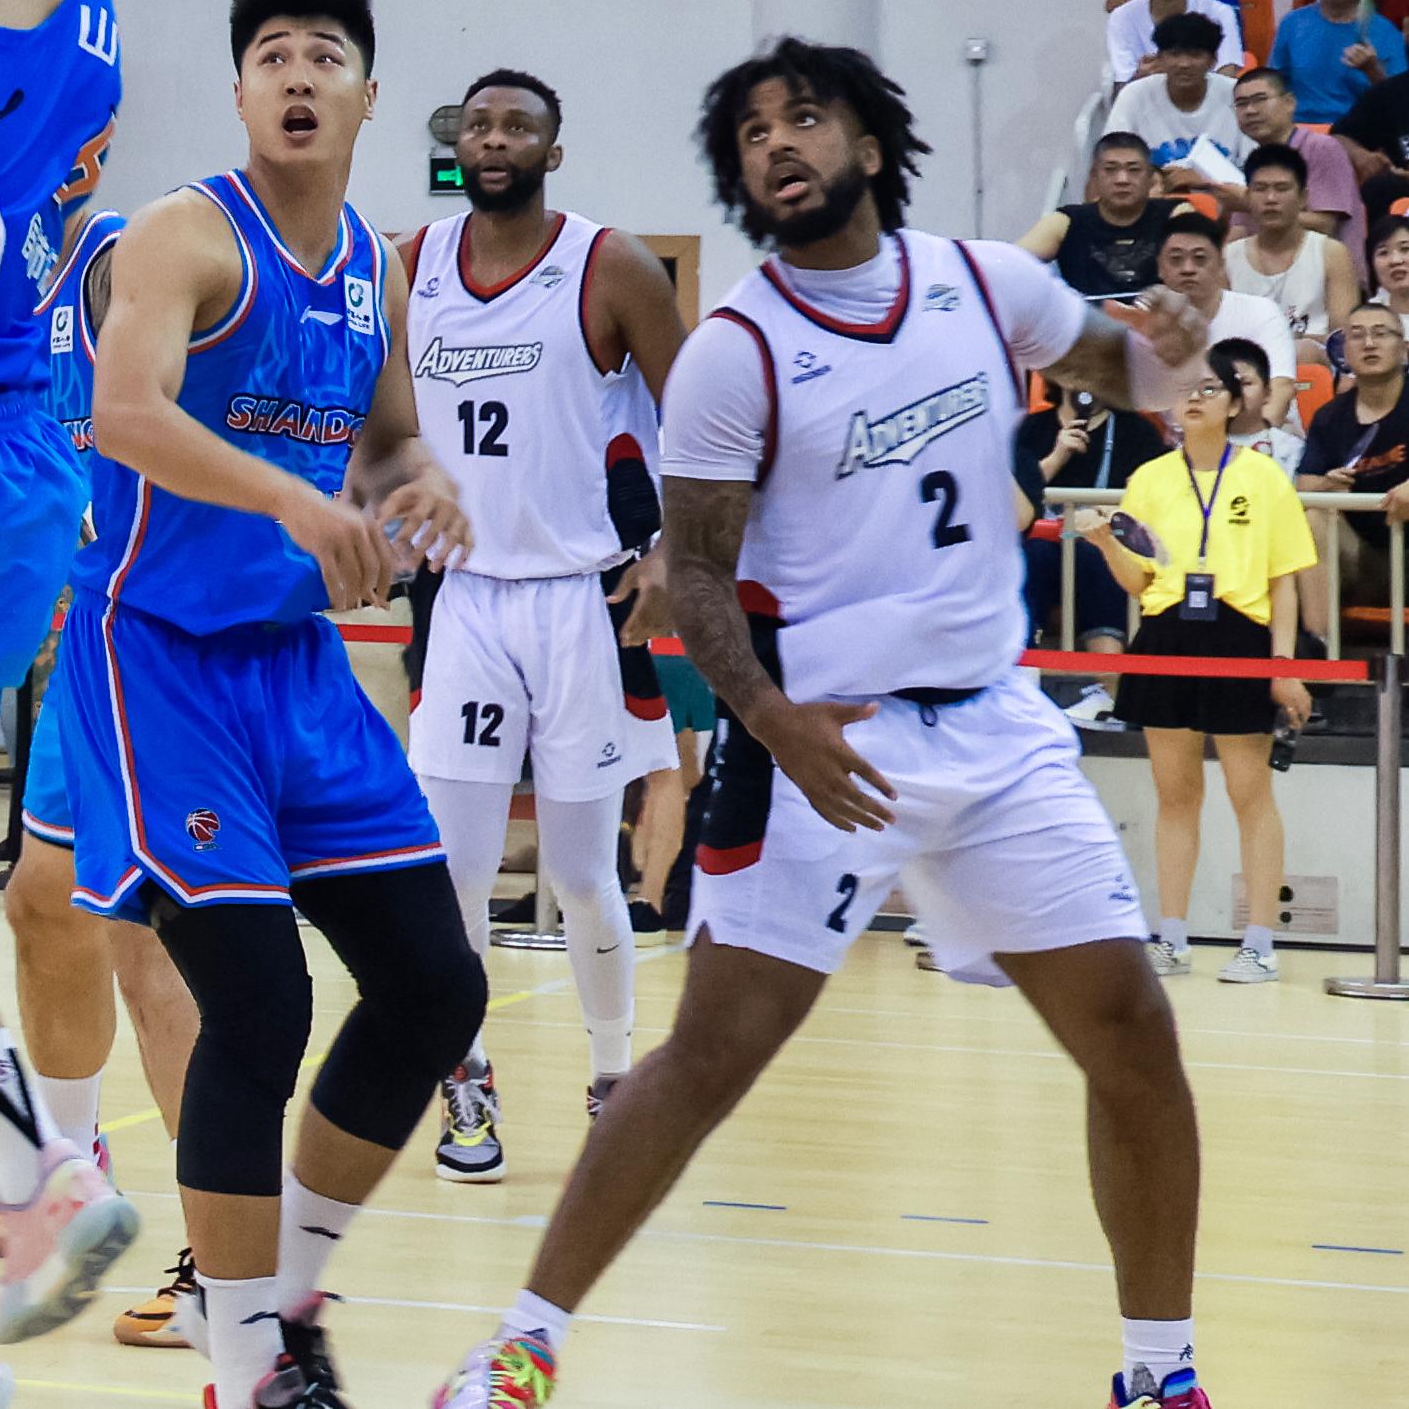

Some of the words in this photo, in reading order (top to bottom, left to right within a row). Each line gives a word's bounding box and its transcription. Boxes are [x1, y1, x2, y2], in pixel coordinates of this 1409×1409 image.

[457, 399, 509, 457] 12
[920, 469, 974, 550] 2
[460, 701, 505, 747] 12
[826, 872, 859, 934] 2
